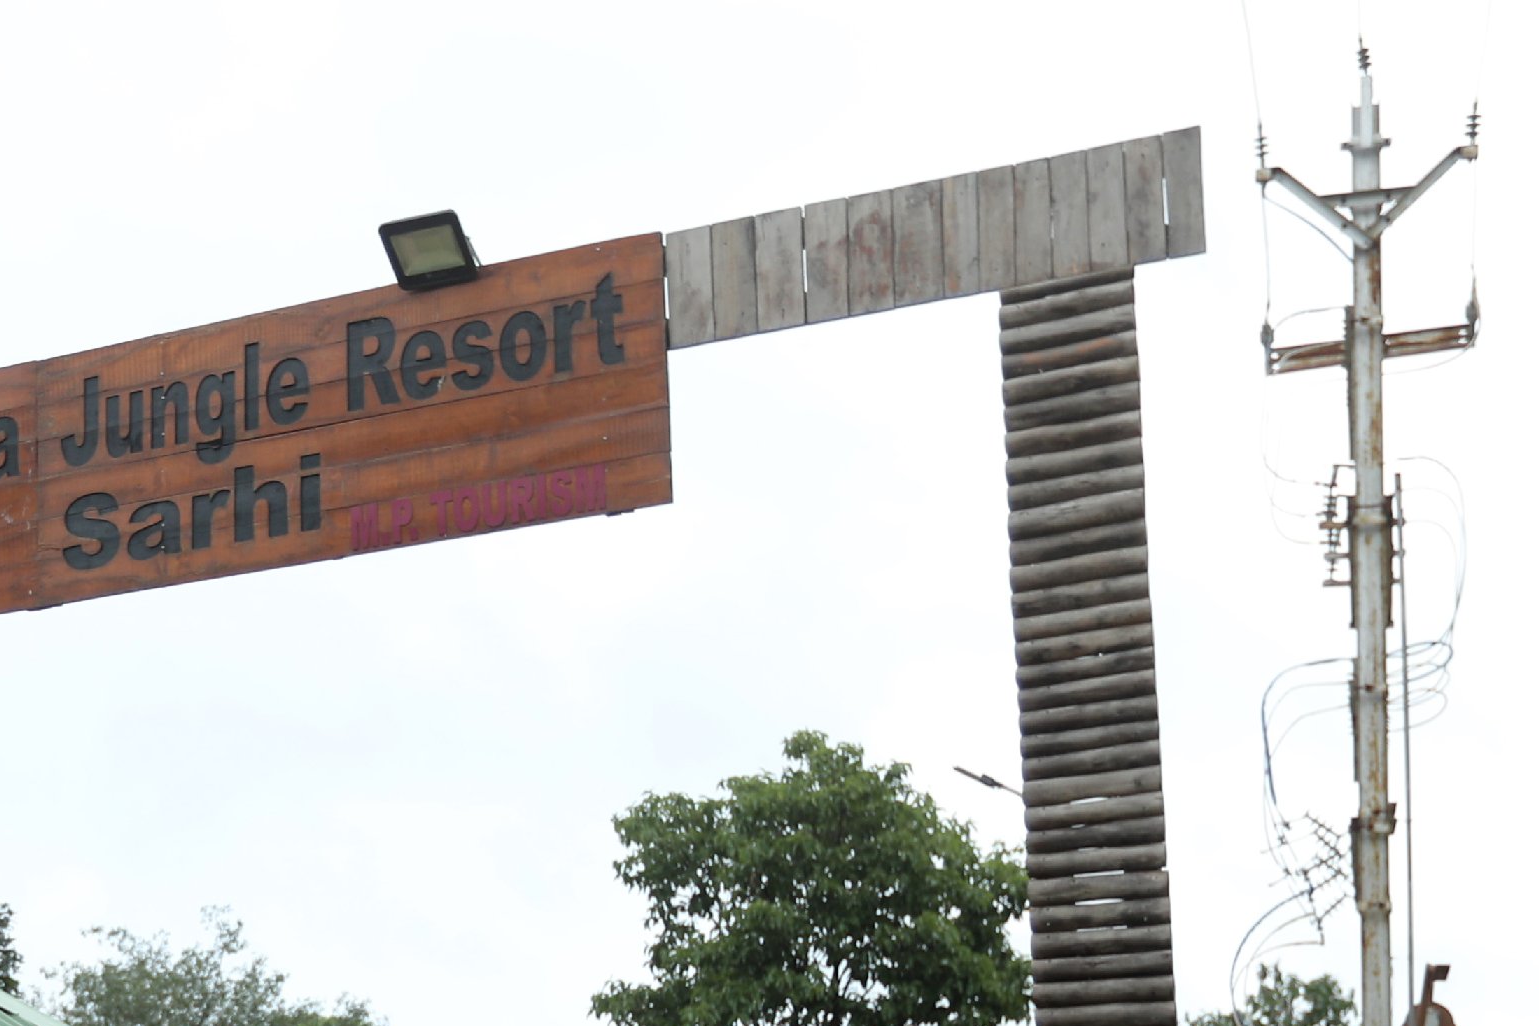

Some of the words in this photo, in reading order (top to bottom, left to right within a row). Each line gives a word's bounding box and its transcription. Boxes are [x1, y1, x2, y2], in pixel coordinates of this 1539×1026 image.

[61, 342, 309, 467] Jungle
[347, 271, 625, 411] Resort
[63, 453, 321, 570] Sarhi
[349, 499, 418, 550] M.P.
[430, 464, 607, 536] TOURISM
